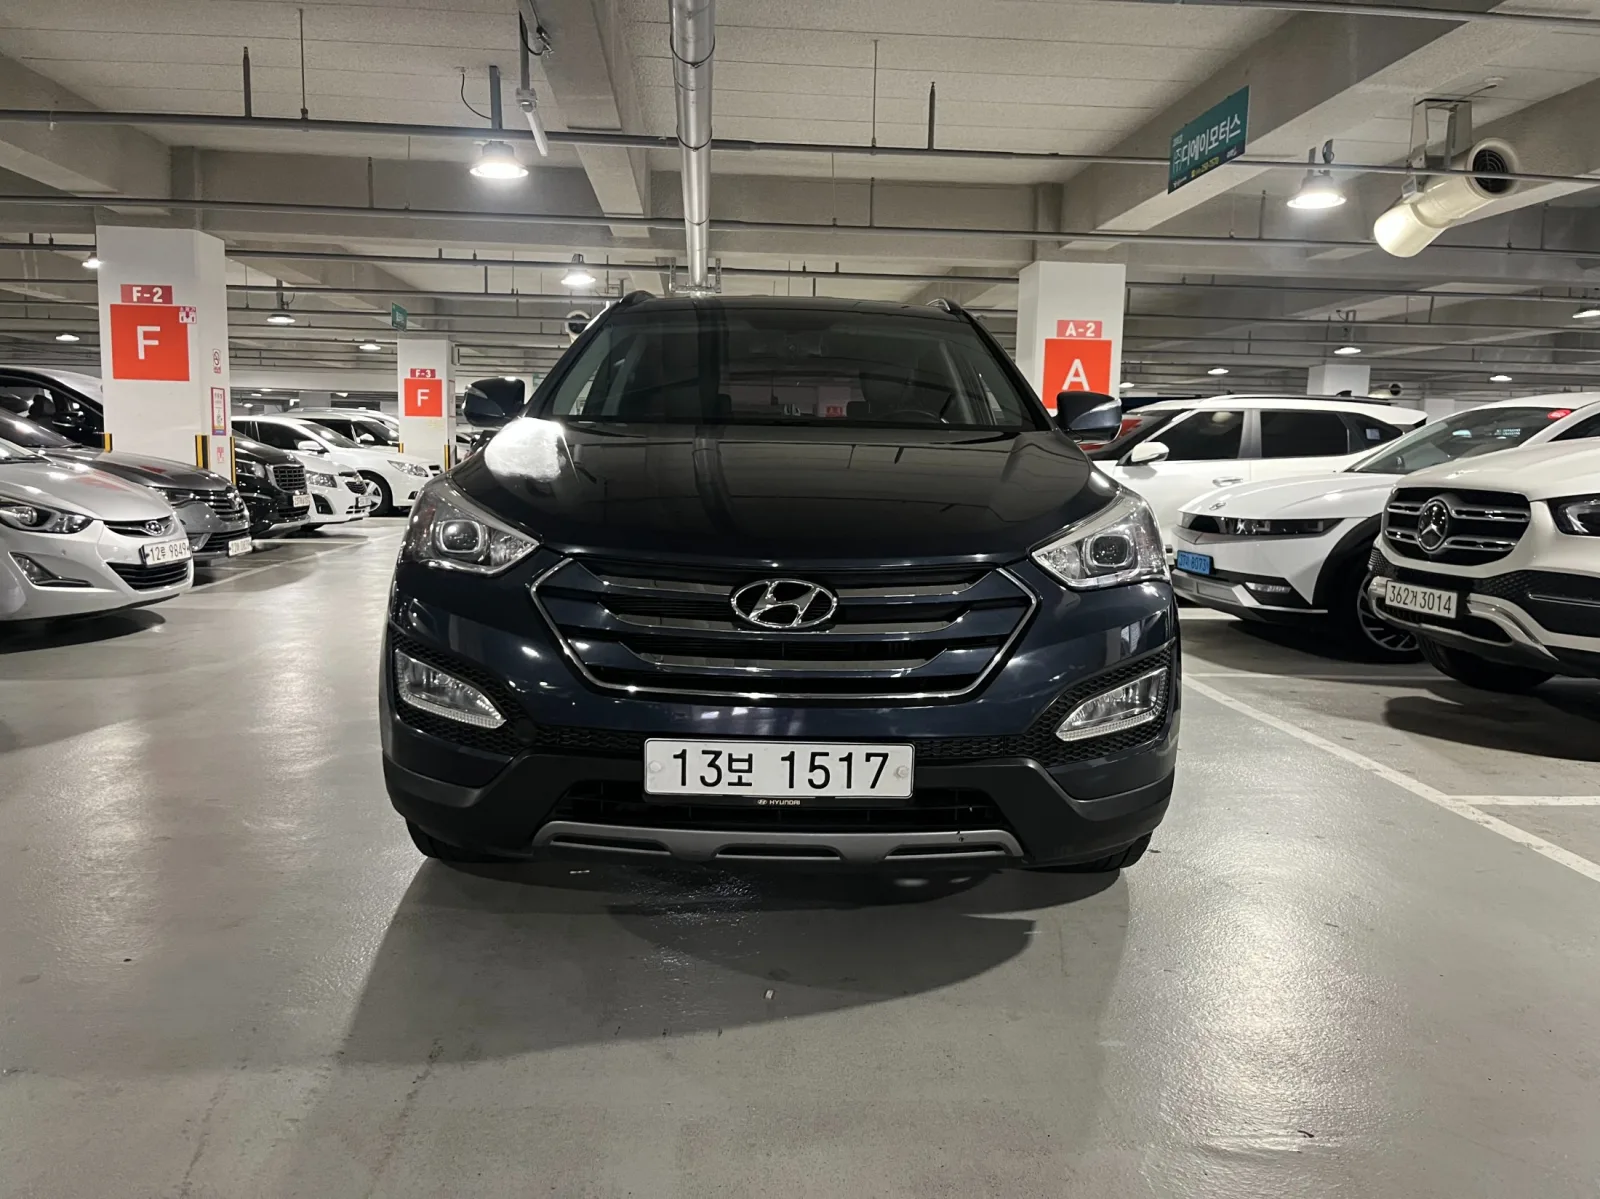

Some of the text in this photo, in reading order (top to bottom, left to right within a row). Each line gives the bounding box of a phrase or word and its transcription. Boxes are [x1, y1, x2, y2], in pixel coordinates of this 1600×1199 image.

[132, 286, 163, 303] F-2
[1065, 321, 1095, 337] A-2
[137, 325, 161, 360] F
[415, 369, 432, 378] F-3
[1061, 358, 1090, 391] A
[417, 389, 430, 407] F
[169, 542, 187, 559] 9849
[1419, 591, 1452, 614] 3014
[672, 748, 890, 789] 13보 1517
